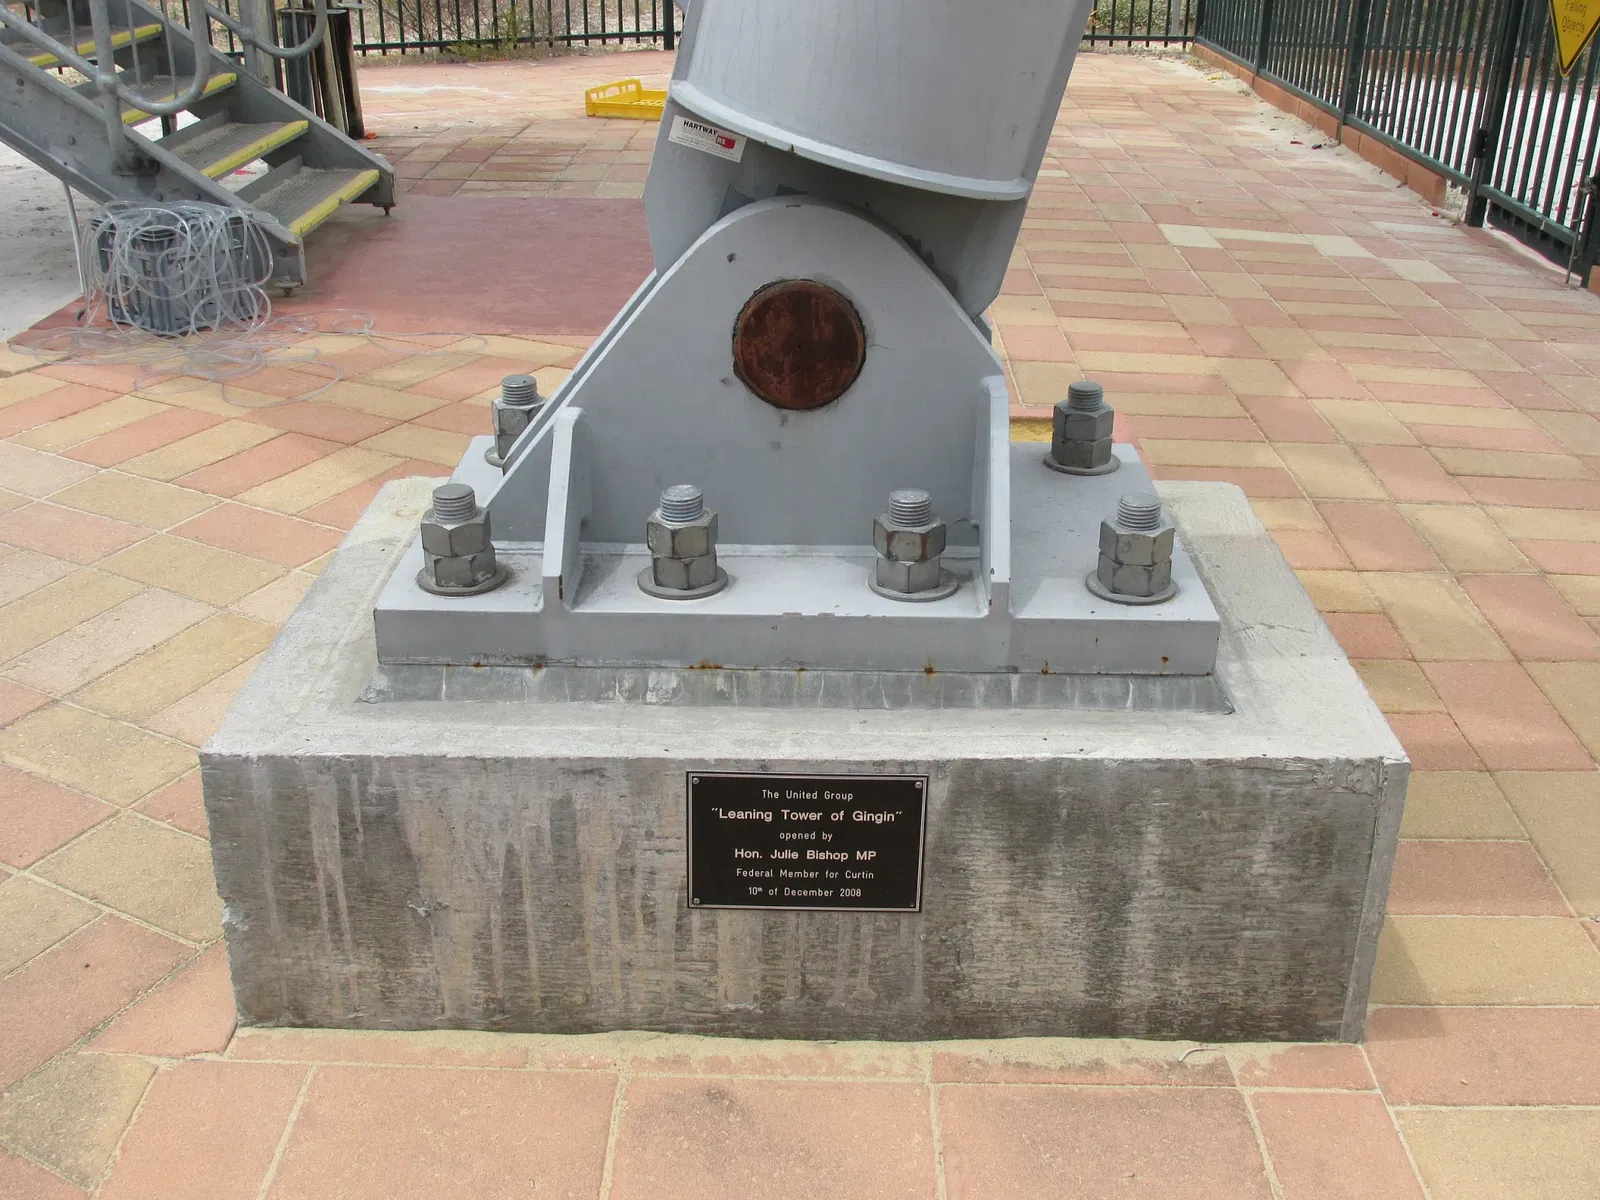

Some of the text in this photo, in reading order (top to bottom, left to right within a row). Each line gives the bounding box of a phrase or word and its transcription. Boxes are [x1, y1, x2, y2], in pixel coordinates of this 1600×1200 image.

[683, 119, 718, 136] HARTWAY
[762, 789, 854, 802] The United Group
[780, 809, 823, 822] Tower
[830, 810, 845, 822] of
[779, 831, 833, 842] opened by
[734, 848, 877, 862] Hon. Julie Bishop MP
[736, 868, 874, 880] Federal Member for Curtin
[768, 887, 778, 896] of
[784, 887, 834, 897] December
[839, 888, 862, 897] 2008
